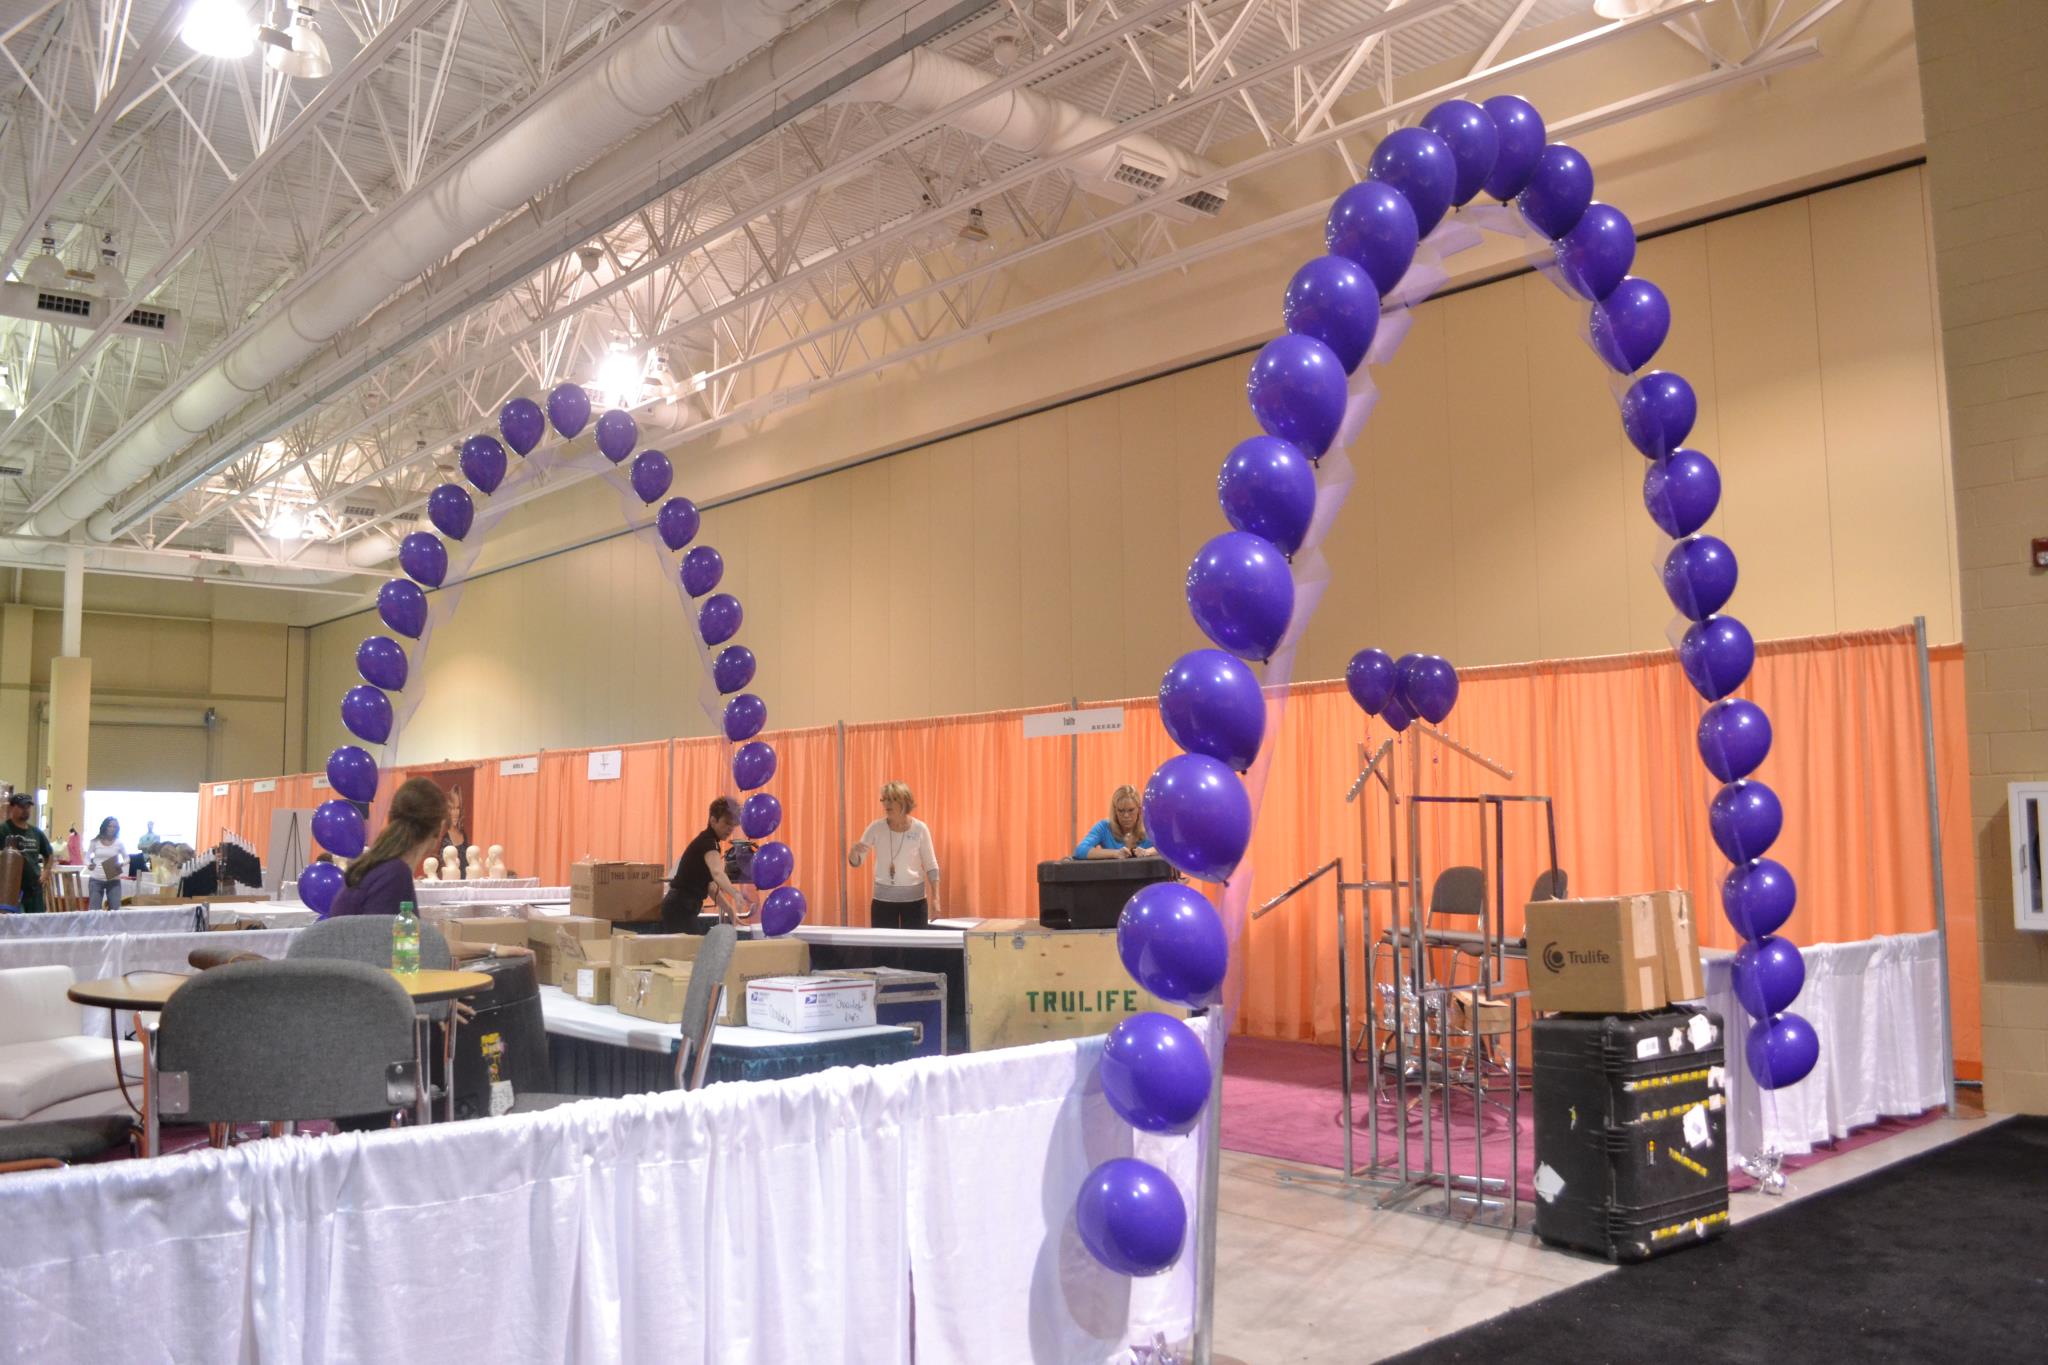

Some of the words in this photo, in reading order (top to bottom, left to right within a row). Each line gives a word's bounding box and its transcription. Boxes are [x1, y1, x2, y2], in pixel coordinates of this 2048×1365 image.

[611, 871, 625, 880] THIS
[1567, 950, 1610, 964] Trulife
[1026, 990, 1137, 1012] TRULIFE
